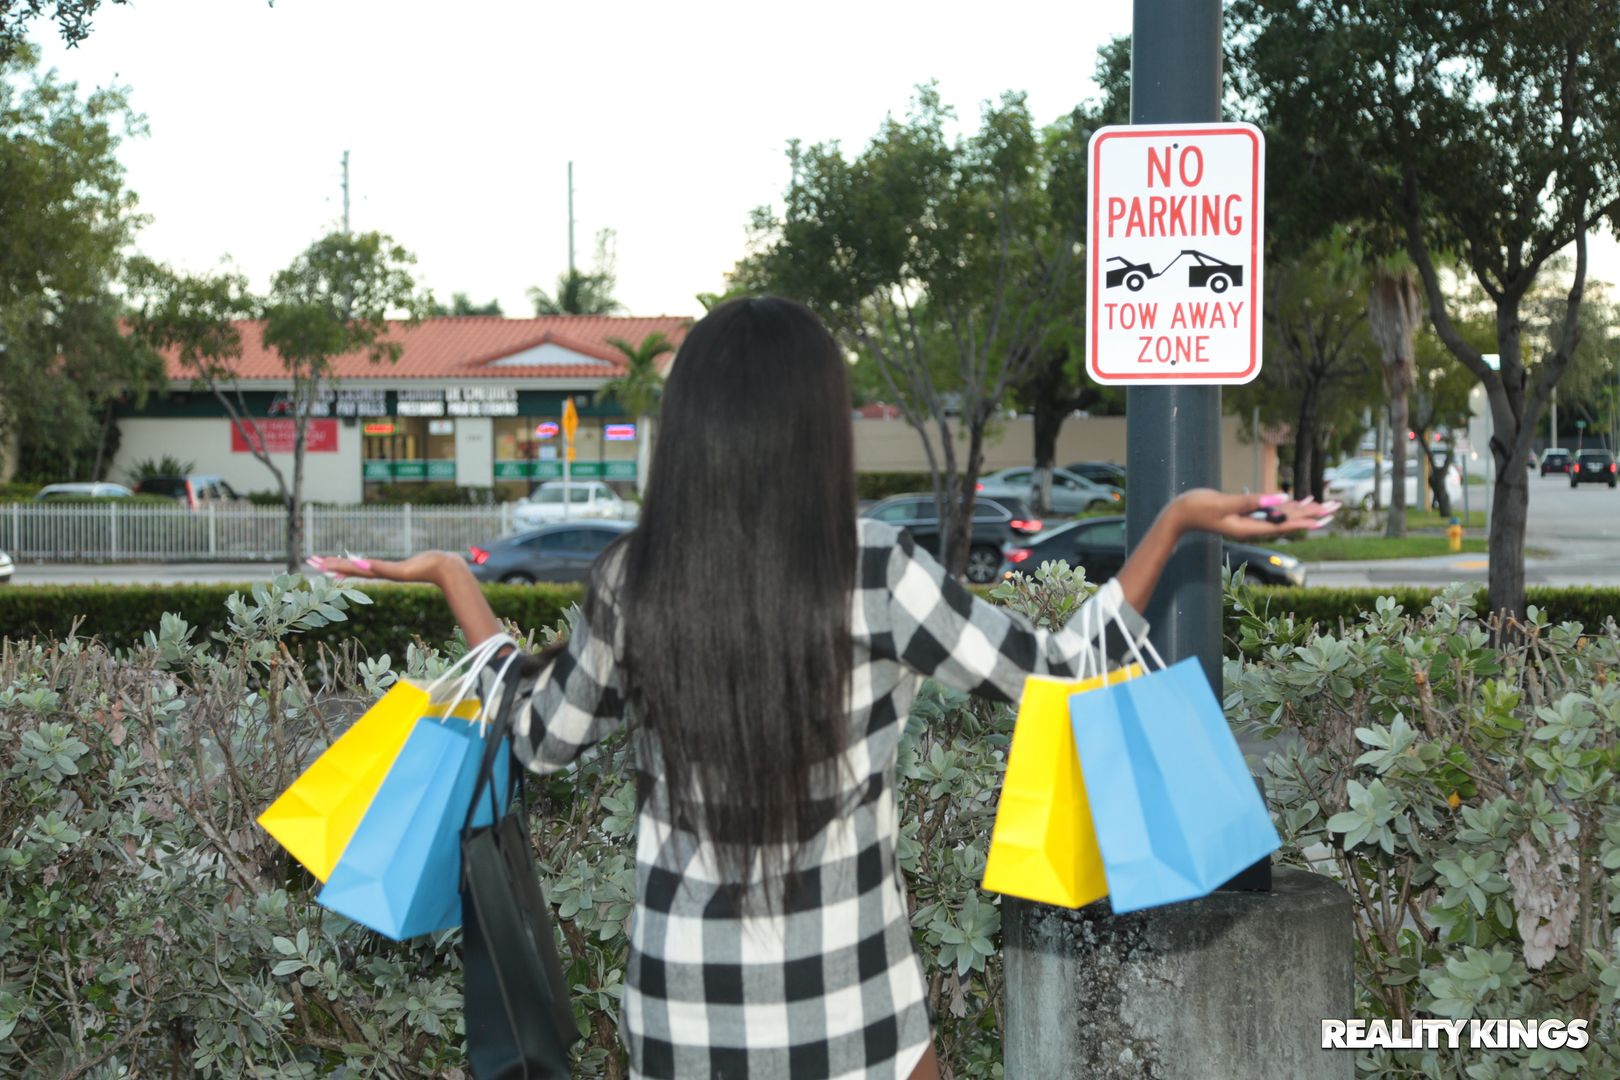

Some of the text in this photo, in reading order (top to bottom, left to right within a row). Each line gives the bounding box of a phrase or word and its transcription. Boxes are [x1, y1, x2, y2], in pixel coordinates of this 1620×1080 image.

[1147, 145, 1204, 188] NO
[1107, 194, 1243, 238] PARKING
[1104, 301, 1244, 330] TOW AWAY
[1137, 335, 1210, 363] ZONE
